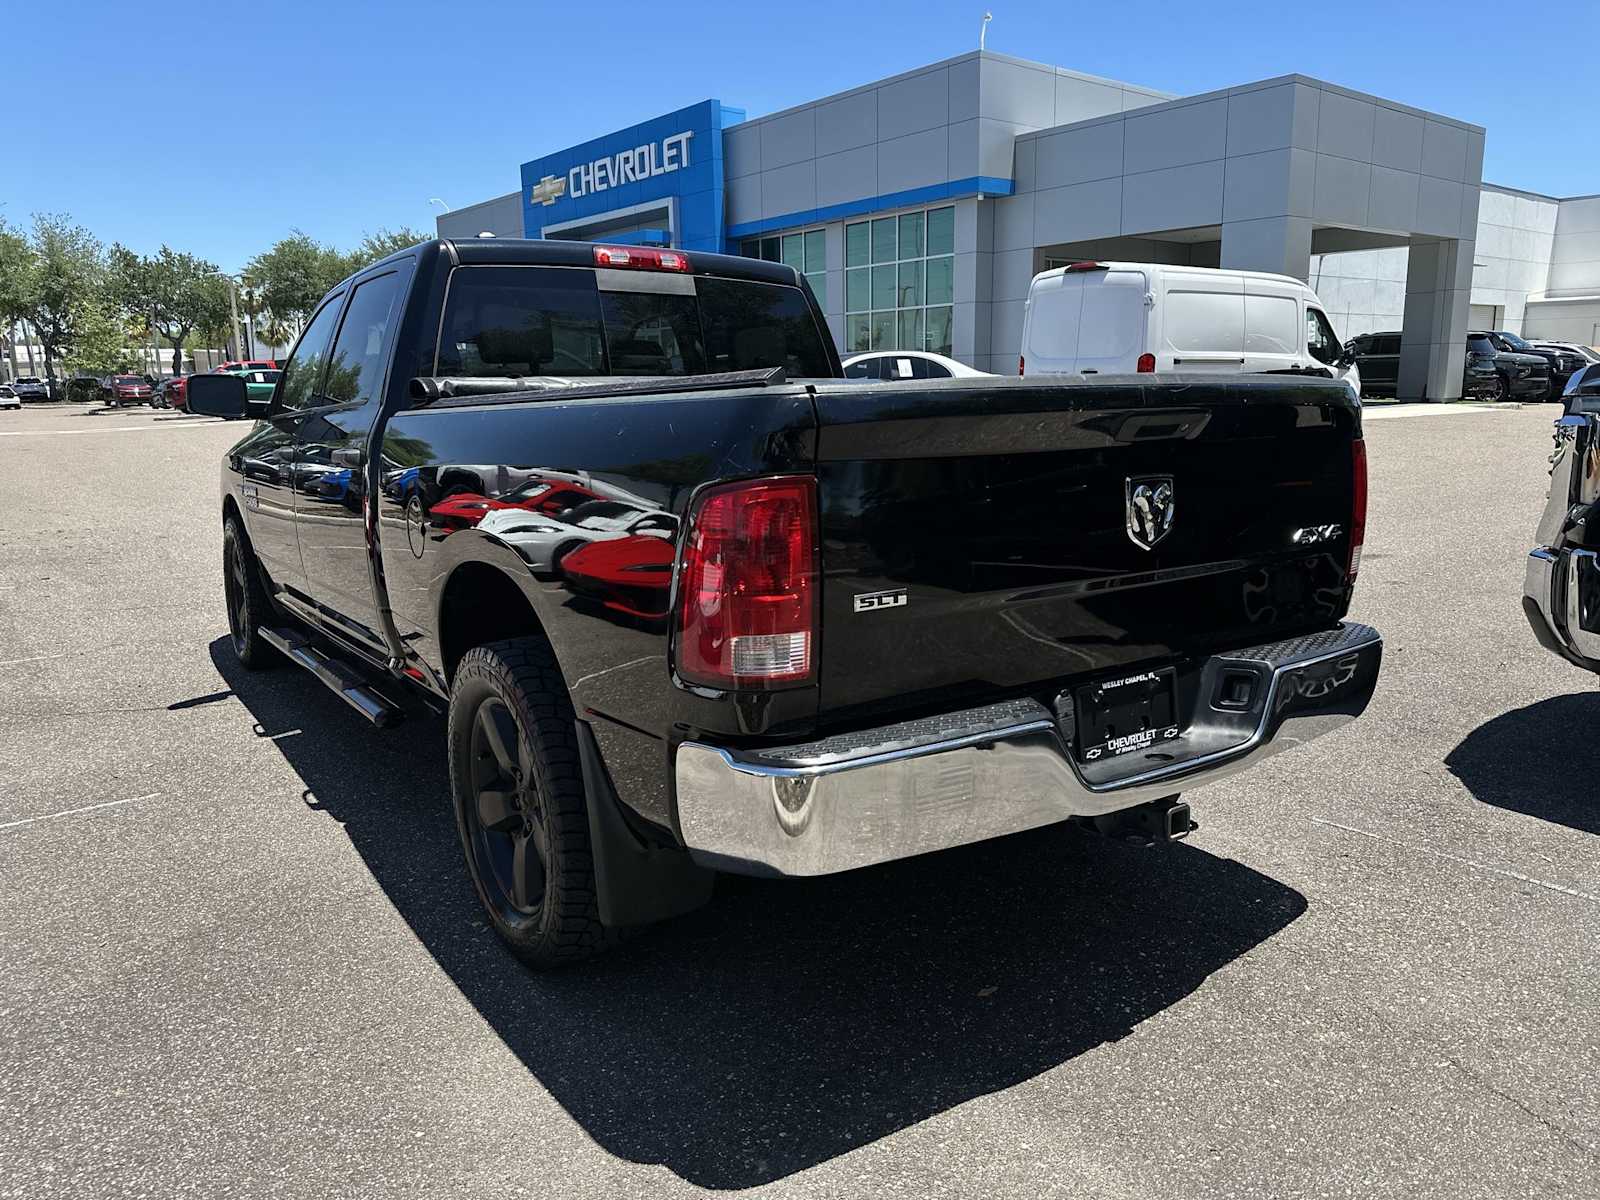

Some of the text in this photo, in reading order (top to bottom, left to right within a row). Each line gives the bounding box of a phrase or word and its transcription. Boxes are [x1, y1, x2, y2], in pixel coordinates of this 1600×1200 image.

[569, 130, 694, 198] CHEVROLET
[854, 588, 907, 613] SLT
[1102, 679, 1124, 689] WESLEY
[1107, 729, 1157, 750] CHEVROLET
